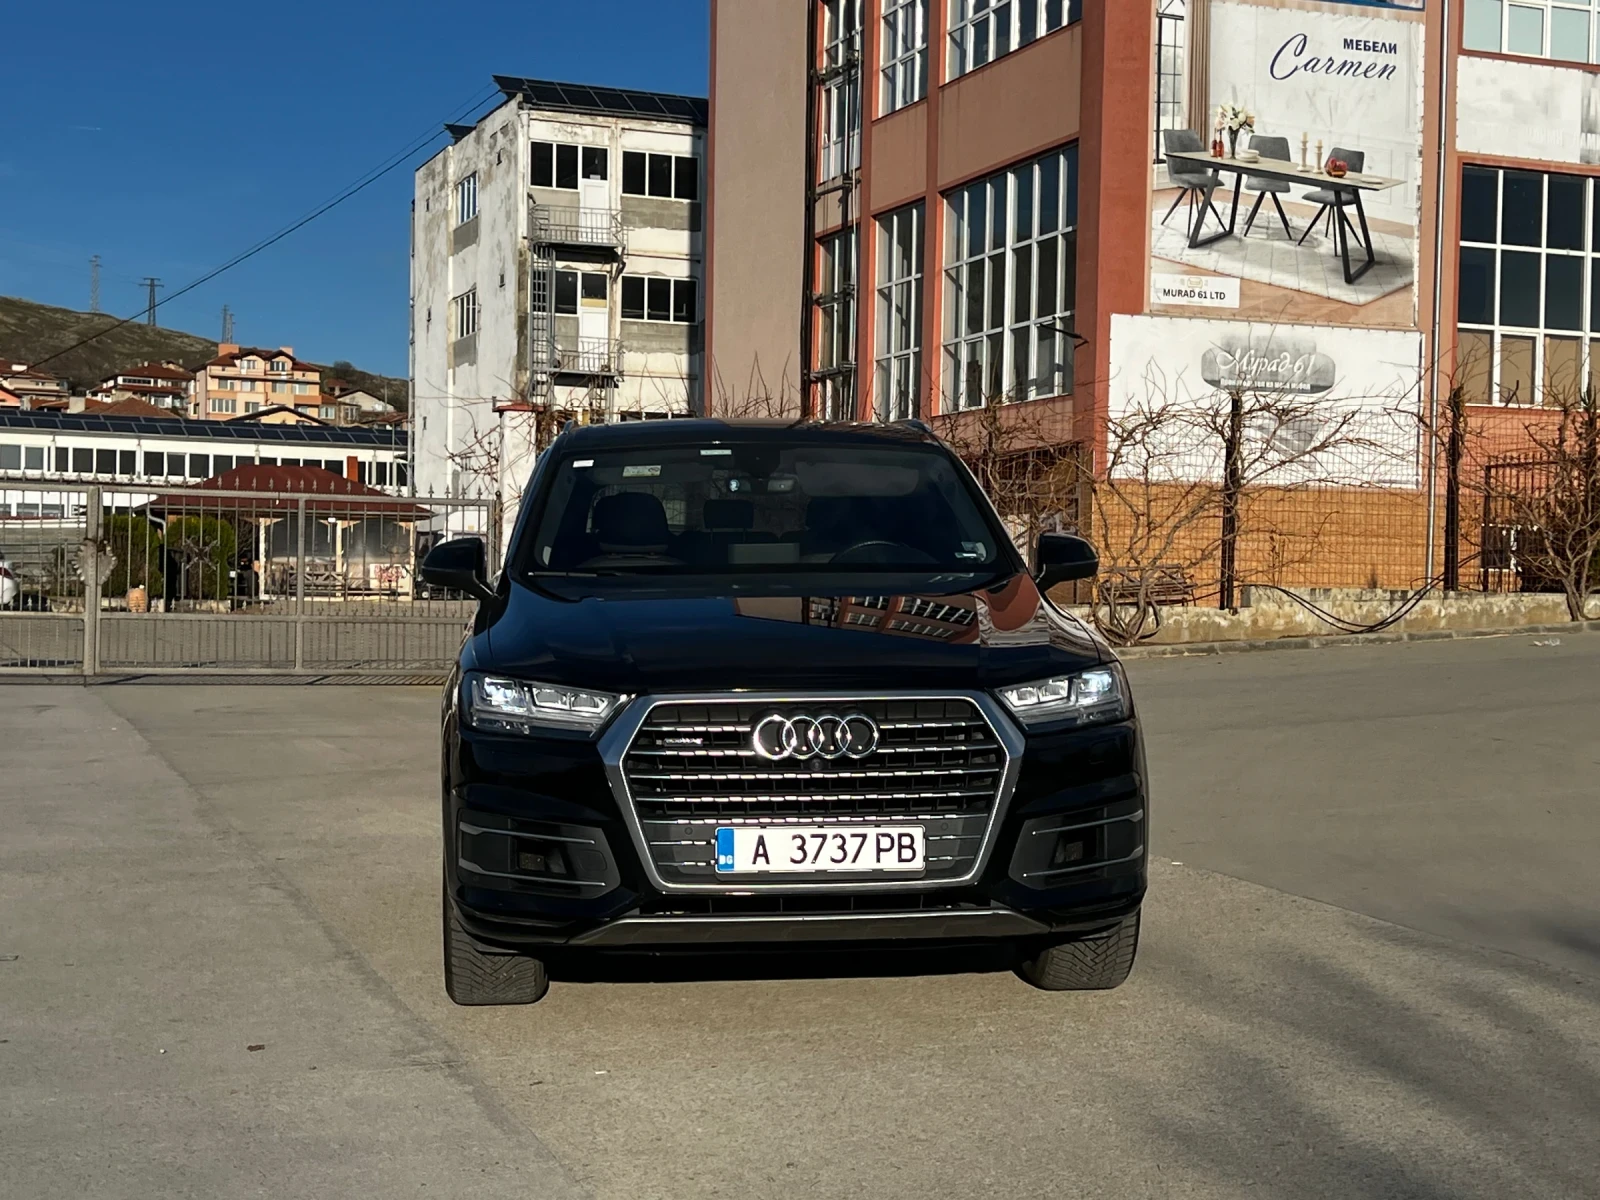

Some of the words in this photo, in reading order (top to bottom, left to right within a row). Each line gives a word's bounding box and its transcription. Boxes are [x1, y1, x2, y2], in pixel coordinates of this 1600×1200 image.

[1343, 38, 1397, 54] МЕБЕЛИ
[1269, 33, 1397, 80] Carmen
[1162, 288, 1196, 298] MURAD
[1198, 291, 1208, 299] 61
[1210, 291, 1226, 300] LTD
[752, 834, 770, 865] A
[718, 854, 733, 865] BG
